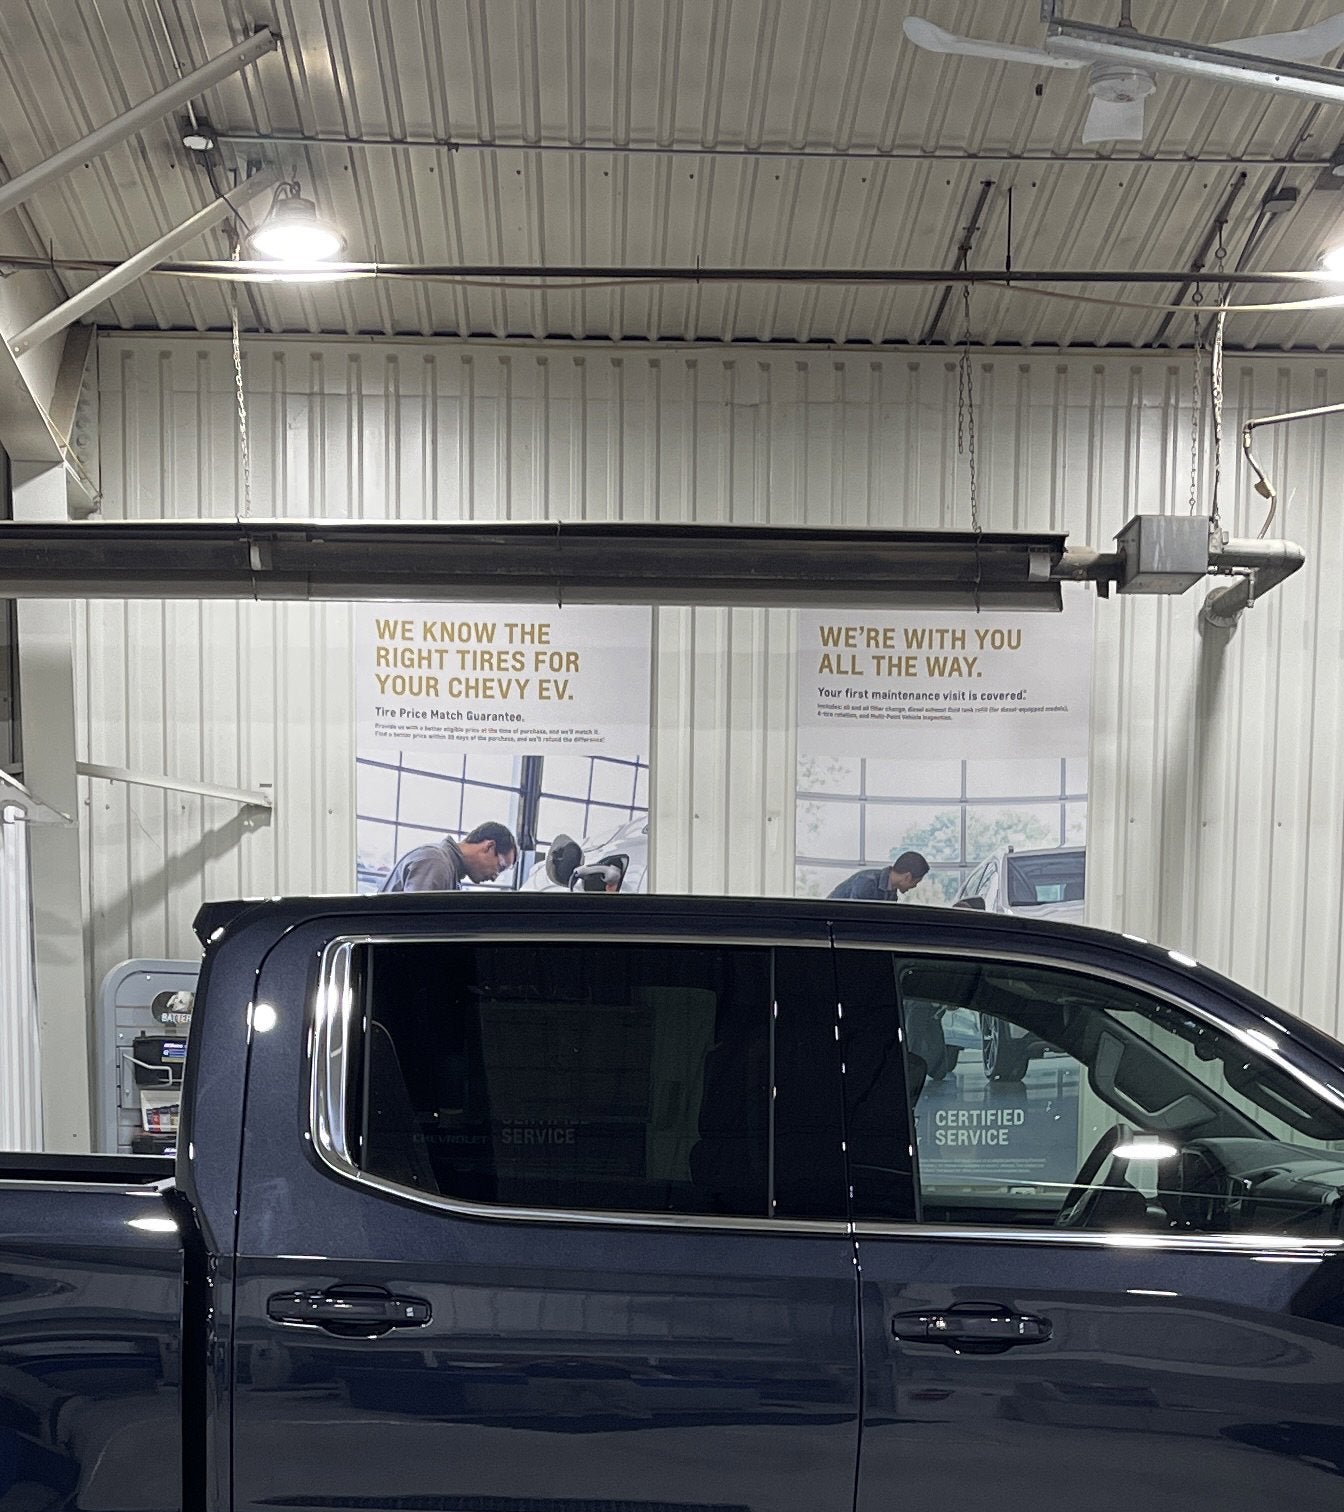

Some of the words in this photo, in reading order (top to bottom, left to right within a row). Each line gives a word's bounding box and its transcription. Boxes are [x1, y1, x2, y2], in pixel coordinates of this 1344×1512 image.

[375, 619, 414, 641] WE
[423, 621, 497, 644] KNOW
[504, 622, 551, 645] THE
[819, 626, 895, 649] WE'RE
[904, 628, 966, 650] WITH
[975, 628, 1022, 650] YOU
[376, 646, 448, 670] RIGHT
[456, 649, 525, 672] TIRES
[534, 651, 579, 673] FOR
[818, 653, 864, 676] ALL
[871, 655, 918, 677] THE
[926, 656, 982, 678] WAY.
[375, 674, 439, 697] YOUR
[448, 677, 530, 700] CHEVY
[538, 679, 574, 700] EV.
[818, 687, 842, 698] Your
[845, 688, 868, 699] first
[872, 690, 941, 700] maintenance
[943, 690, 965, 700] visit
[969, 690, 977, 700] is
[375, 707, 396, 717] Tire
[400, 708, 427, 719] Price
[431, 709, 462, 720] Match
[467, 711, 525, 722] Guarantee.
[161, 1012, 192, 1023] BATTER
[935, 1109, 1024, 1126] CERTIFIED
[501, 1128, 575, 1144] SERVICE
[935, 1129, 1009, 1146] SERVICE
